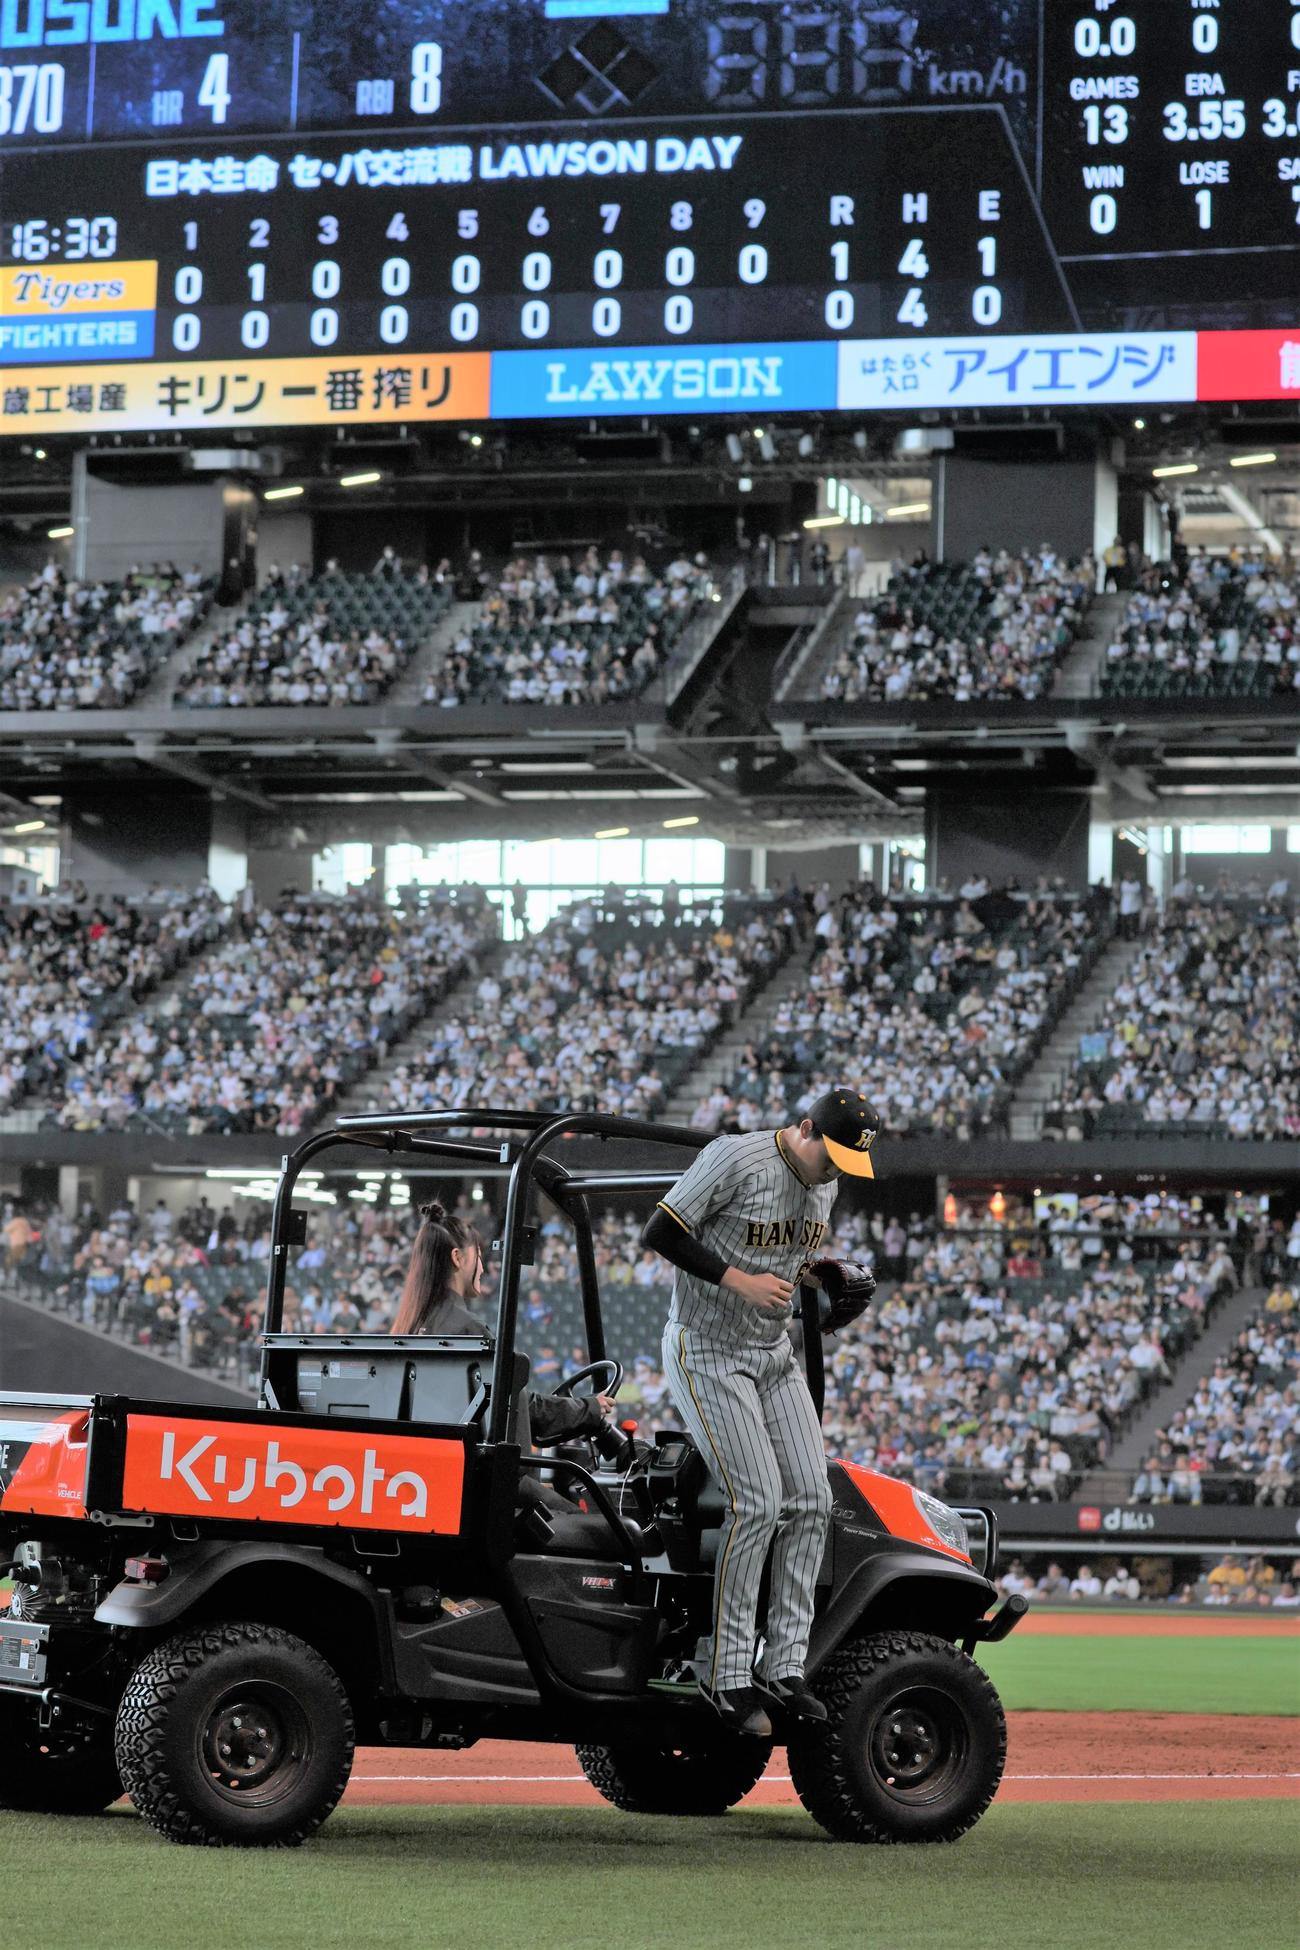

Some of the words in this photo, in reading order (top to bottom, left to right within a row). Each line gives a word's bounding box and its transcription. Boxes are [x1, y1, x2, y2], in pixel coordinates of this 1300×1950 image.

[1074, 17, 1136, 57] 0.0
[1192, 14, 1219, 53] 0
[152, 91, 184, 125] HR
[198, 53, 231, 124] 4
[356, 79, 394, 115] RBI
[410, 42, 442, 113] 8
[929, 56, 1026, 97] km/h
[1069, 76, 1140, 100] GAMES
[1185, 73, 1225, 96] ERA
[1083, 104, 1129, 145] 13
[1162, 99, 1246, 142] 3.55
[1262, 98, 1300, 138] 3.
[146, 154, 281, 197] 日本生命
[288, 145, 474, 189] セ・パ交流戦
[479, 139, 648, 179] LAWSON
[655, 135, 743, 172] DAY
[1082, 164, 1124, 189] WIN
[1179, 160, 1230, 186] LOSE
[183, 220, 198, 251] 1
[249, 218, 270, 248] 2
[317, 215, 339, 245] 3
[386, 212, 409, 242] 4
[458, 209, 479, 239] 5
[527, 206, 550, 236] 6
[600, 203, 621, 234] 7
[670, 201, 693, 231] 8
[743, 198, 766, 229] 9
[830, 195, 855, 226] R
[902, 192, 928, 223] H
[978, 190, 1001, 221] E
[1089, 194, 1117, 235] 0
[1195, 189, 1212, 230] 1
[12, 216, 118, 261] 16:30
[13, 272, 124, 309] Tigers
[175, 267, 202, 304] 0
[248, 263, 265, 301] 1
[313, 261, 340, 298] 0
[382, 258, 410, 296] 0
[452, 255, 480, 293] 0
[523, 253, 551, 291] 0
[594, 250, 622, 288] 0
[666, 247, 694, 286] 0
[739, 245, 767, 283] 0
[831, 242, 848, 280] 1
[898, 240, 929, 278] 4
[978, 237, 995, 276] 1
[0, 320, 137, 349] FIGHTERS
[173, 313, 200, 350] 0
[242, 311, 269, 348] 0
[311, 308, 338, 346] 0
[380, 305, 408, 343] 0
[451, 303, 478, 341] 0
[521, 300, 549, 339] 0
[593, 298, 621, 336] 0
[665, 295, 693, 334] 0
[825, 290, 854, 329] 0
[897, 288, 928, 327] 4
[973, 286, 1001, 325] 0
[545, 356, 784, 402] LAWSON
[861, 350, 932, 375] はたらく
[883, 374, 919, 394] 入口
[944, 345, 1175, 392] アイエンジ
[159, 1431, 428, 1518] Kubota
